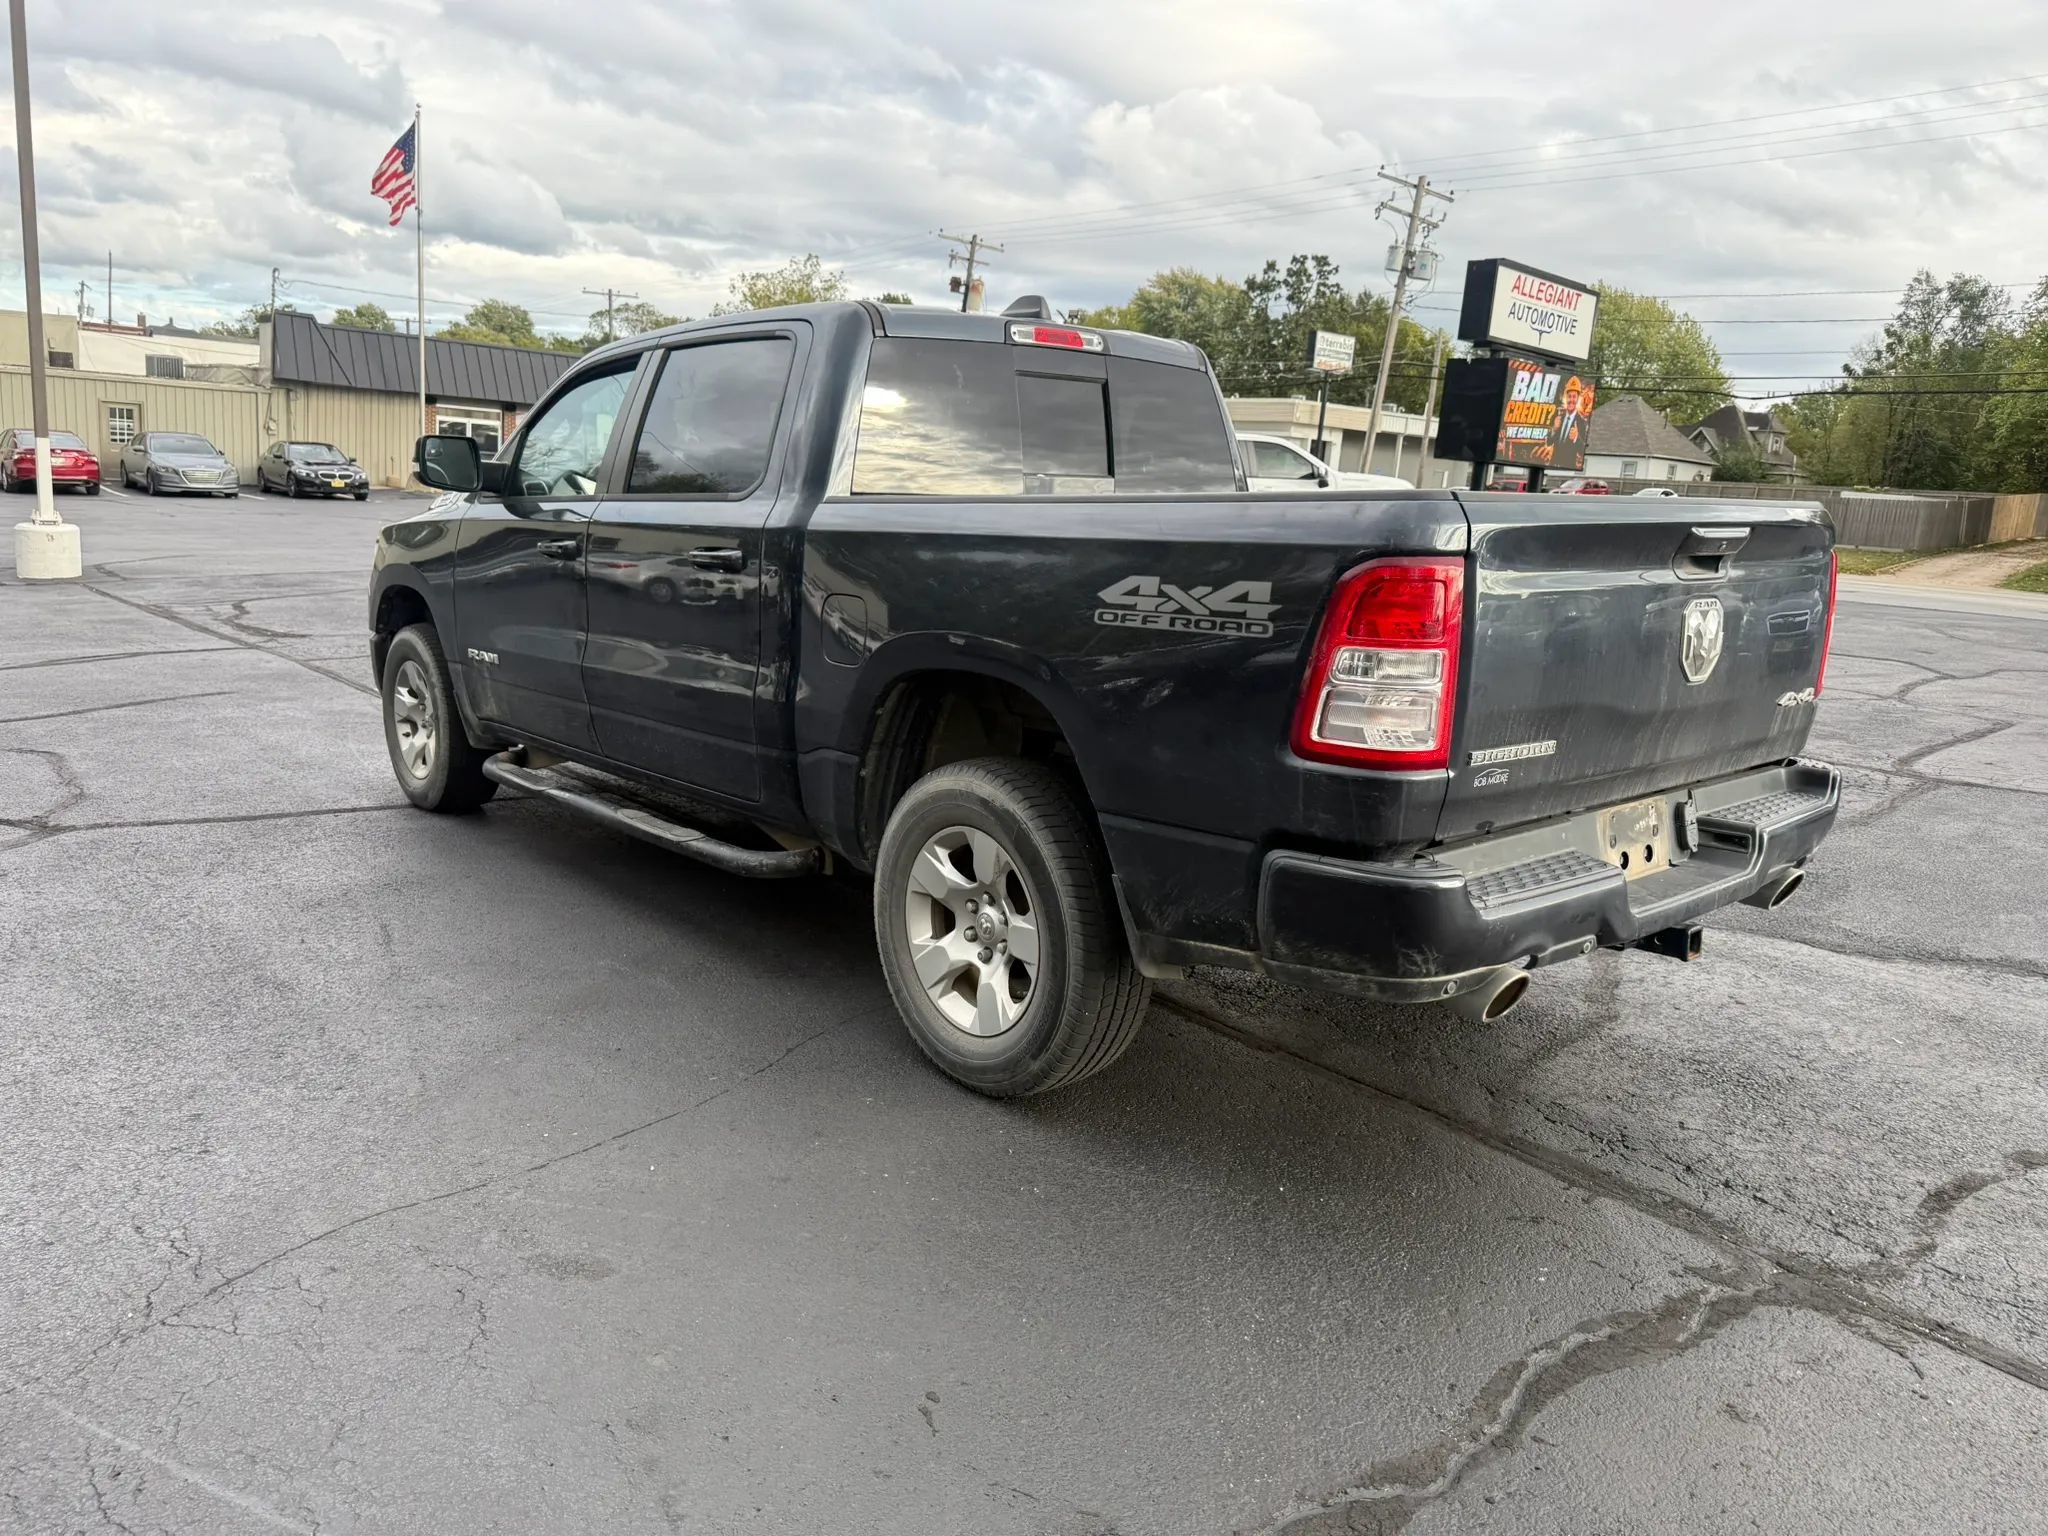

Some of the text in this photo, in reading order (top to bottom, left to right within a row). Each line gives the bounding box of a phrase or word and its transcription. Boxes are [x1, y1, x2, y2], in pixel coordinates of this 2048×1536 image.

[1511, 274, 1583, 311] ALLEGIANT
[1508, 302, 1578, 335] AUTOMOTIVE
[1511, 370, 1561, 403] BAD
[1504, 400, 1556, 425] CREDIT?
[1506, 426, 1519, 438] WE
[1517, 427, 1531, 439] CAN
[1098, 611, 1270, 635] OFF ROAD
[467, 648, 499, 665] RAM
[1473, 773, 1509, 788] BOB MOORE
